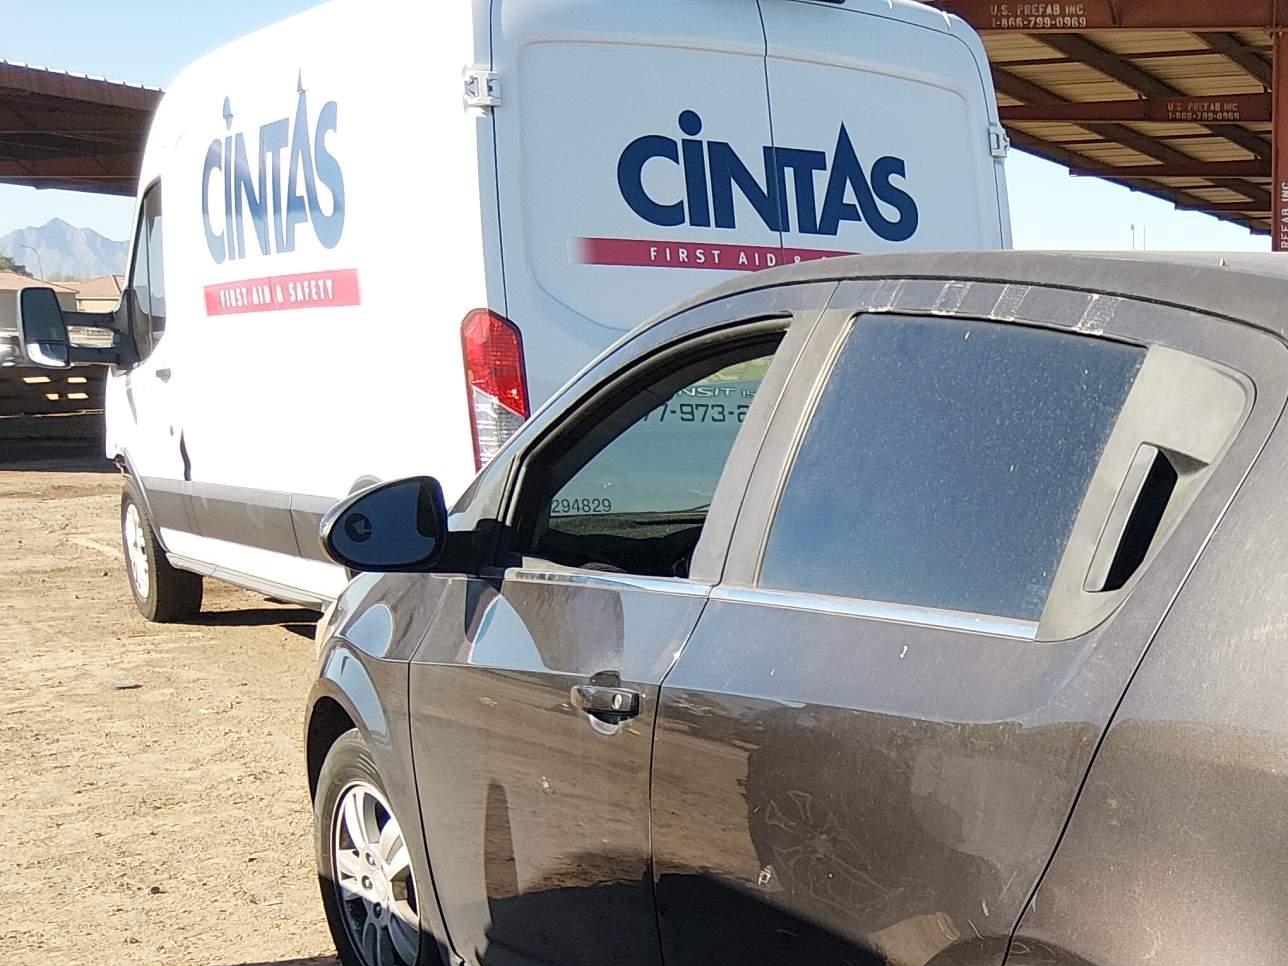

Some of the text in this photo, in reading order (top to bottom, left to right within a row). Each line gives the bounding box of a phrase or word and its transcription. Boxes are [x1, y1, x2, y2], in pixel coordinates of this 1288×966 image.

[1017, 4, 1060, 15] PREFAB
[202, 67, 345, 264] CINTAS
[617, 109, 919, 242] CINTAS
[650, 247, 720, 264] FIRST
[738, 251, 777, 267] AID
[220, 287, 249, 308] FIRST
[252, 284, 271, 305] AID
[288, 279, 334, 303] SAFETY
[676, 387, 737, 398] NSIT
[551, 498, 612, 513] 294829
